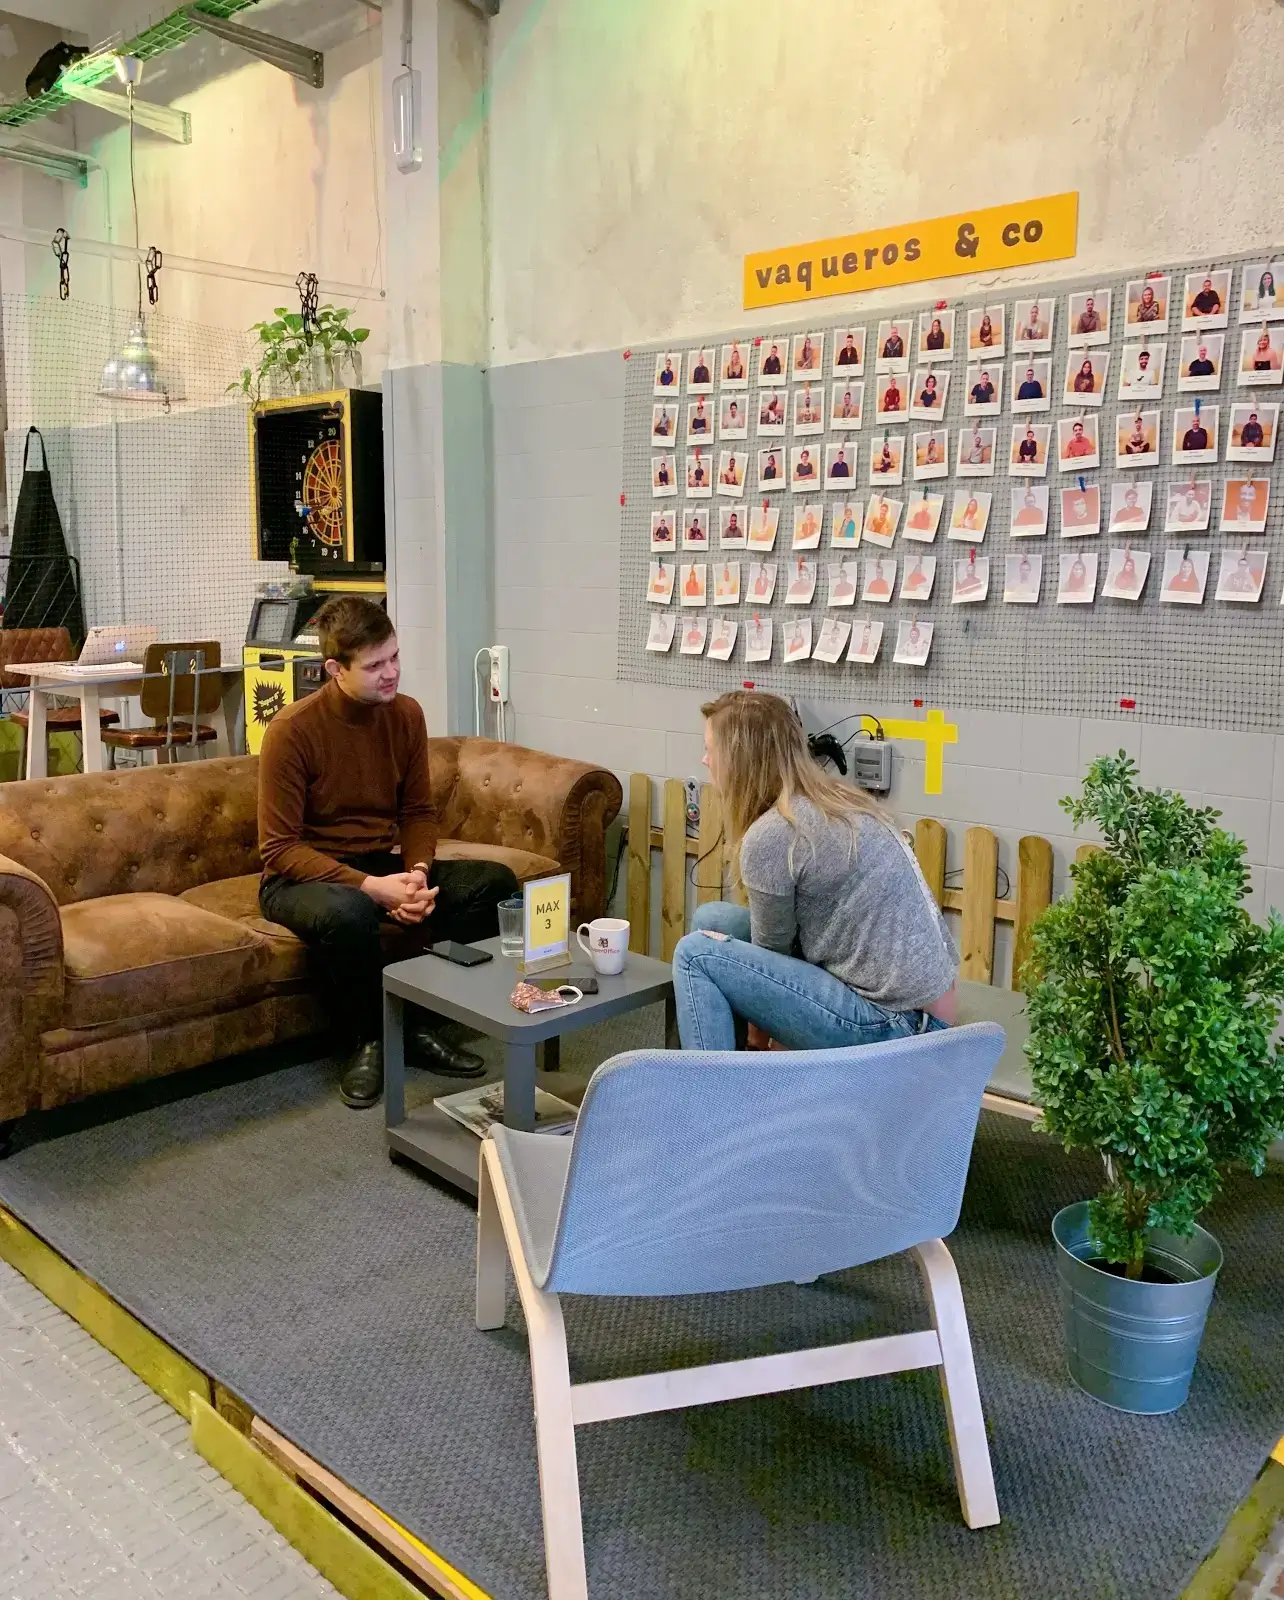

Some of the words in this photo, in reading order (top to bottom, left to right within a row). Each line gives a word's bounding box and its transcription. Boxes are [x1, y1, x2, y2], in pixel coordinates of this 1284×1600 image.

[755, 237, 922, 291] vaqueros
[955, 222, 980, 259] &
[1002, 219, 1043, 247] co
[327, 427, 337, 436] 20
[536, 899, 560, 916] MAX
[544, 918, 552, 930] 3
